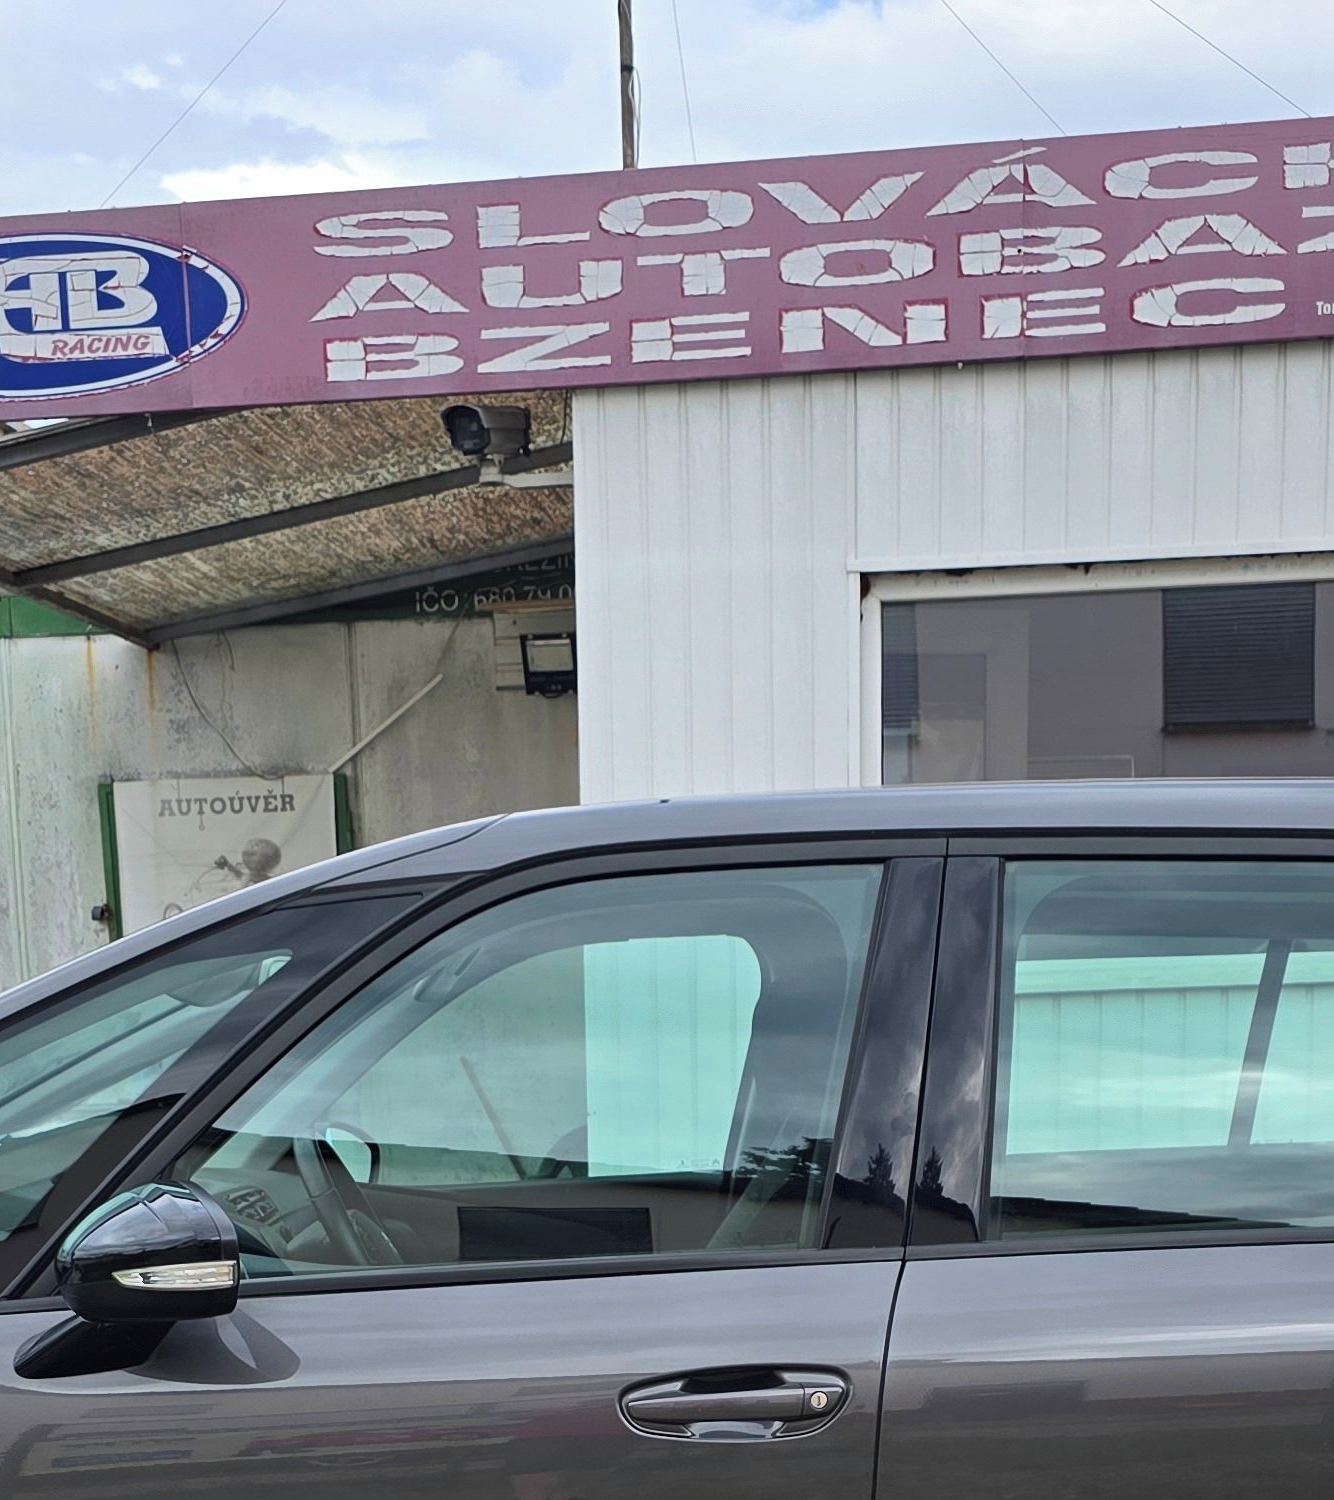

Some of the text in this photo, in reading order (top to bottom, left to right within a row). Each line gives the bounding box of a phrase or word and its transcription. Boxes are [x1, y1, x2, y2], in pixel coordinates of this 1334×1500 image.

[324, 277, 1287, 383] BZENEC
[51, 335, 151, 357] RACING
[415, 585, 459, 612] IČO
[158, 788, 296, 818] AUTOÚVĚR
